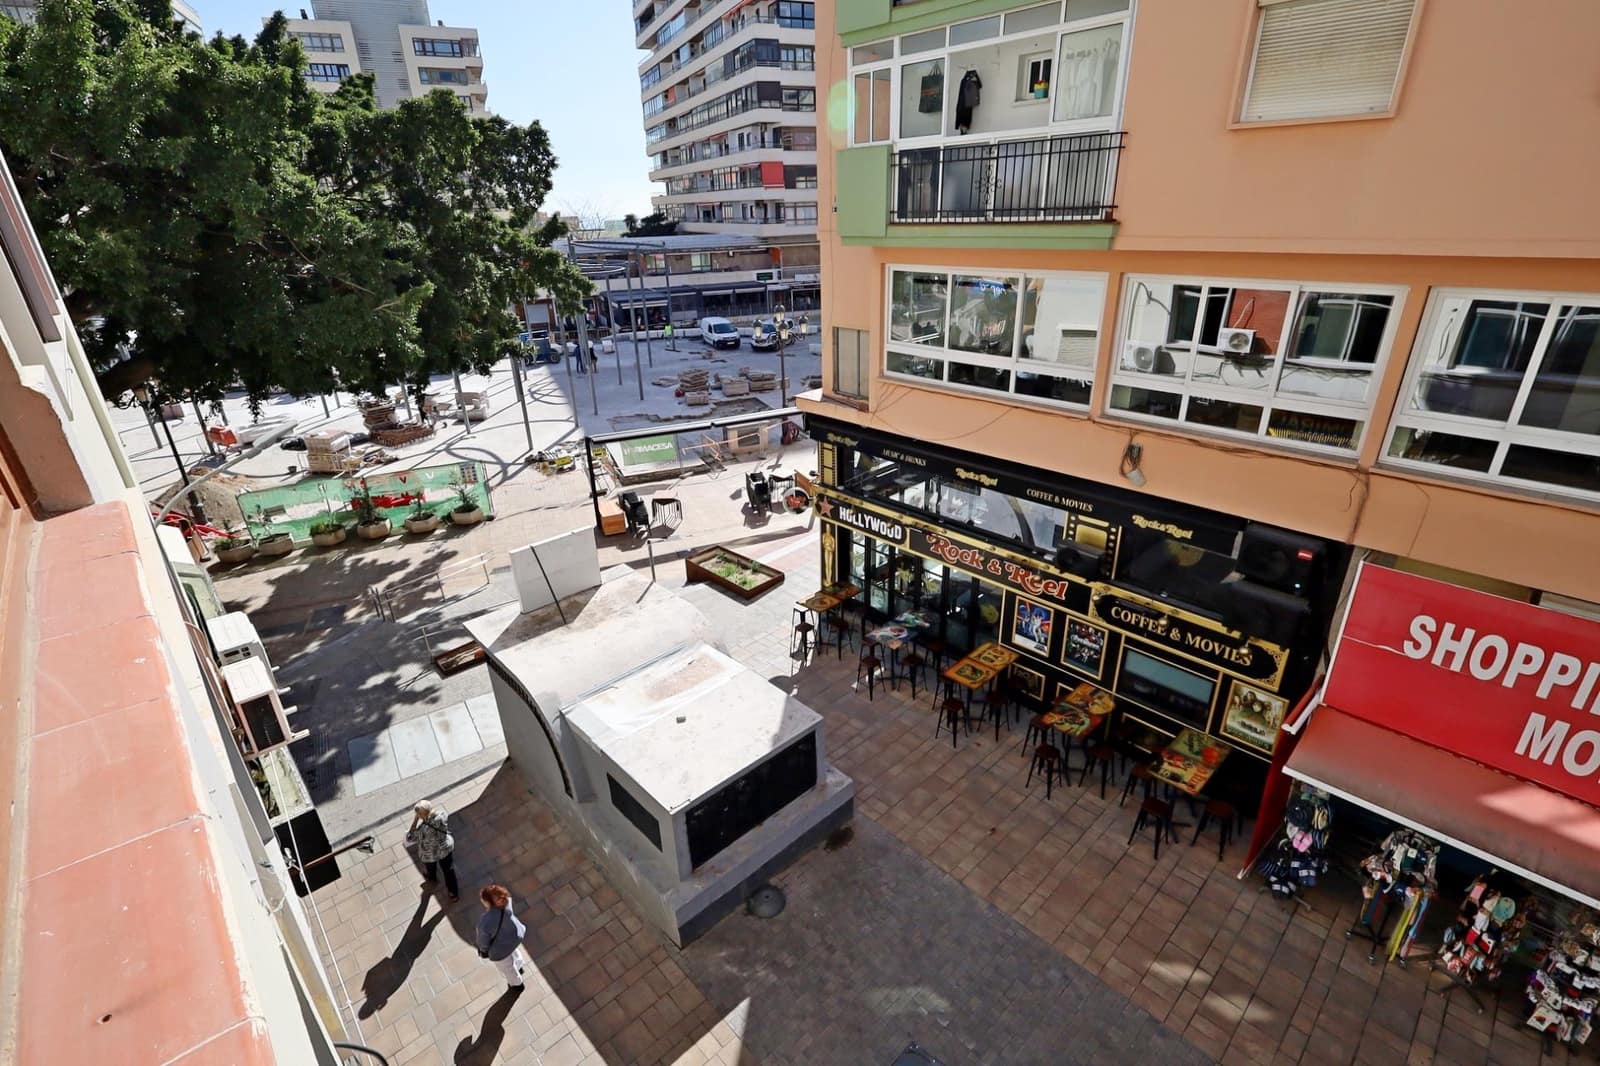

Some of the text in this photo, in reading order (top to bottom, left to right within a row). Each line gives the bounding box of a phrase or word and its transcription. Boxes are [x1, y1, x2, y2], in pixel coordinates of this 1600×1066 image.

[839, 506, 902, 540] HOLLYWOOD
[1026, 488, 1053, 501] COFFEE
[1061, 497, 1094, 512] MOVIES
[926, 533, 1068, 600] Rock & Reel
[1111, 606, 1253, 667] COFFEE & MOVIES
[1514, 711, 1600, 783] MO
